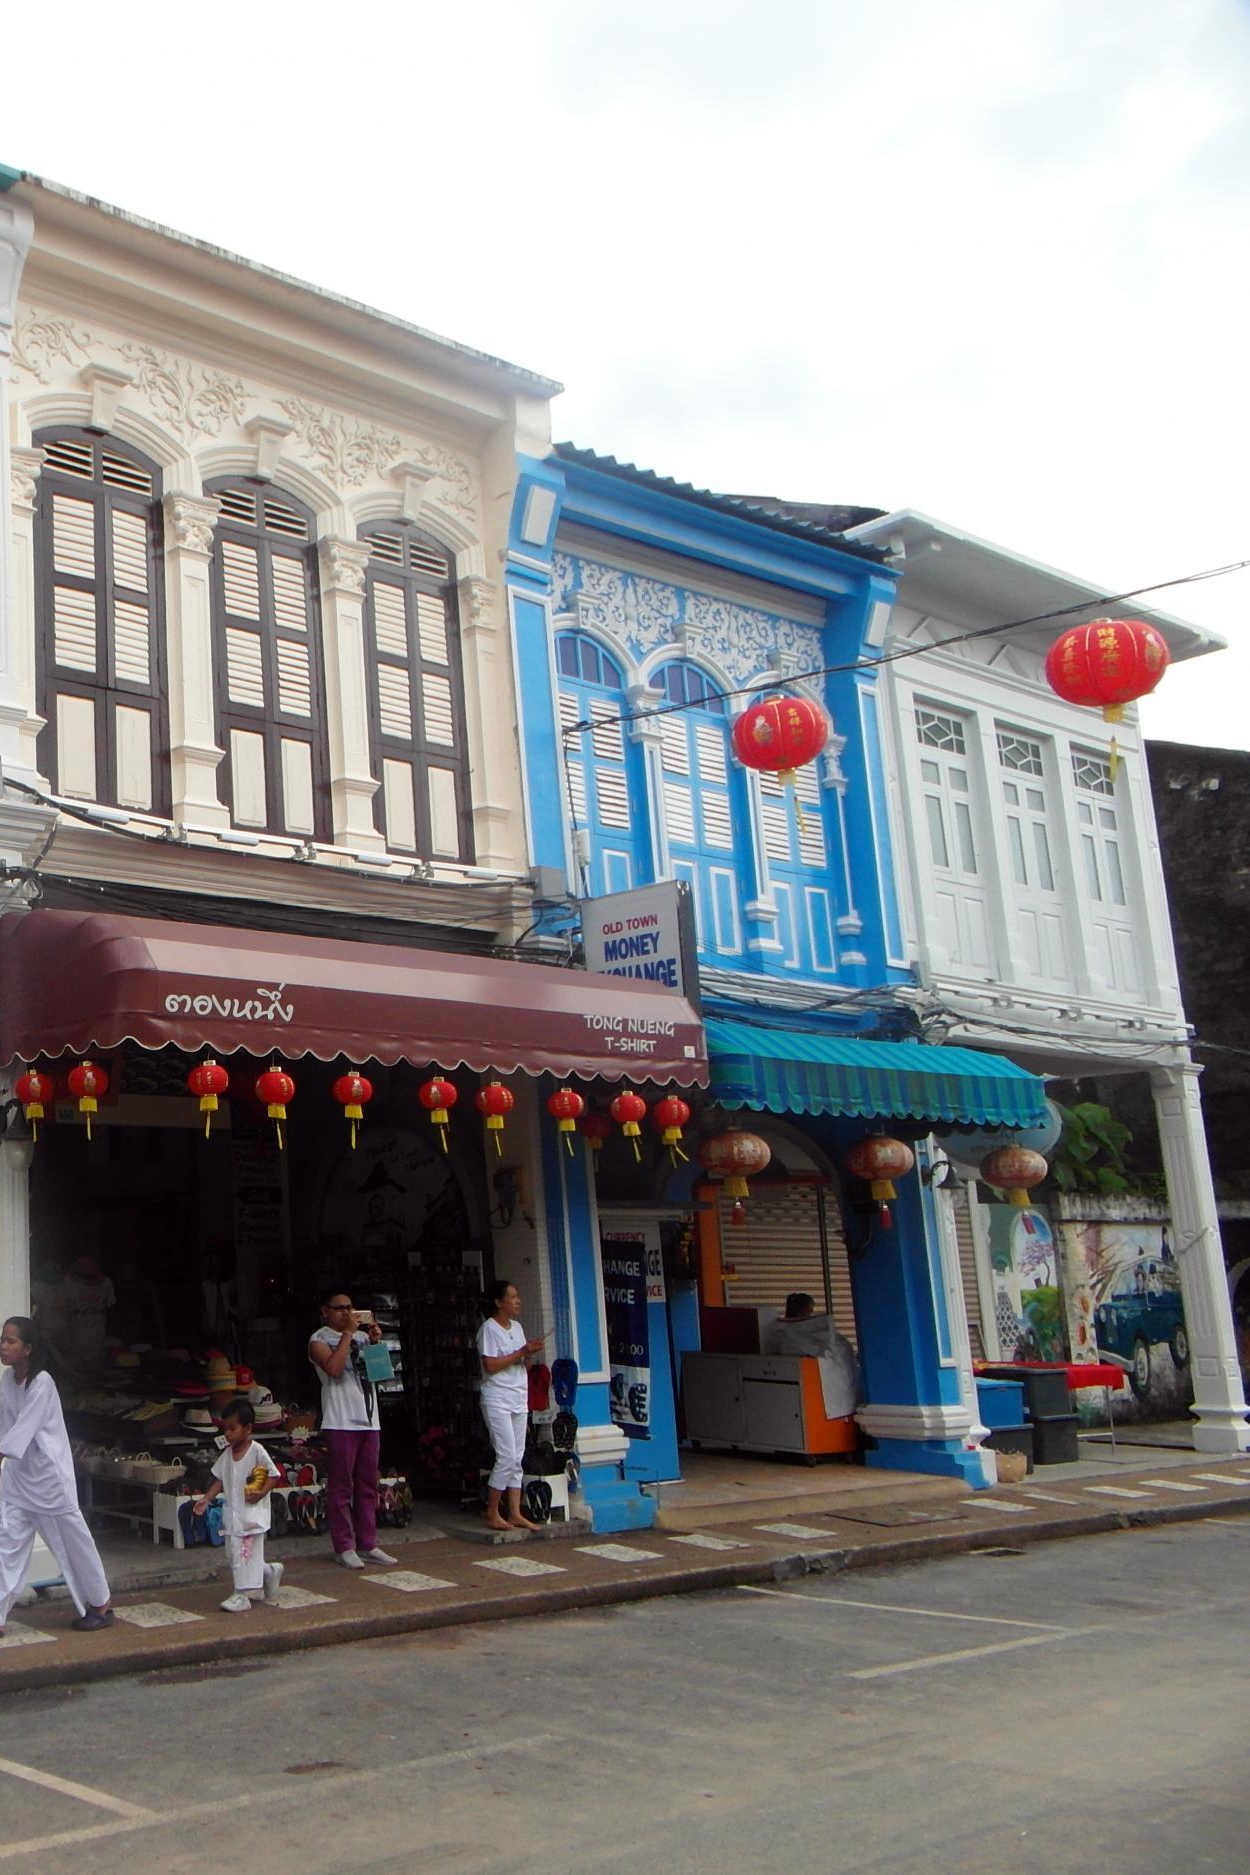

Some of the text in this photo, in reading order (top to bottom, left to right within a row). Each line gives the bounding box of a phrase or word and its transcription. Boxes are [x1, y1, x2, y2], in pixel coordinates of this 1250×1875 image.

[602, 914, 659, 935] OLD TOWN
[604, 931, 661, 962] MONEY
[164, 982, 294, 1022] ตองหนึ่ง
[583, 1014, 675, 1037] TONG NUENG
[604, 1036, 657, 1053] T-SHIRT
